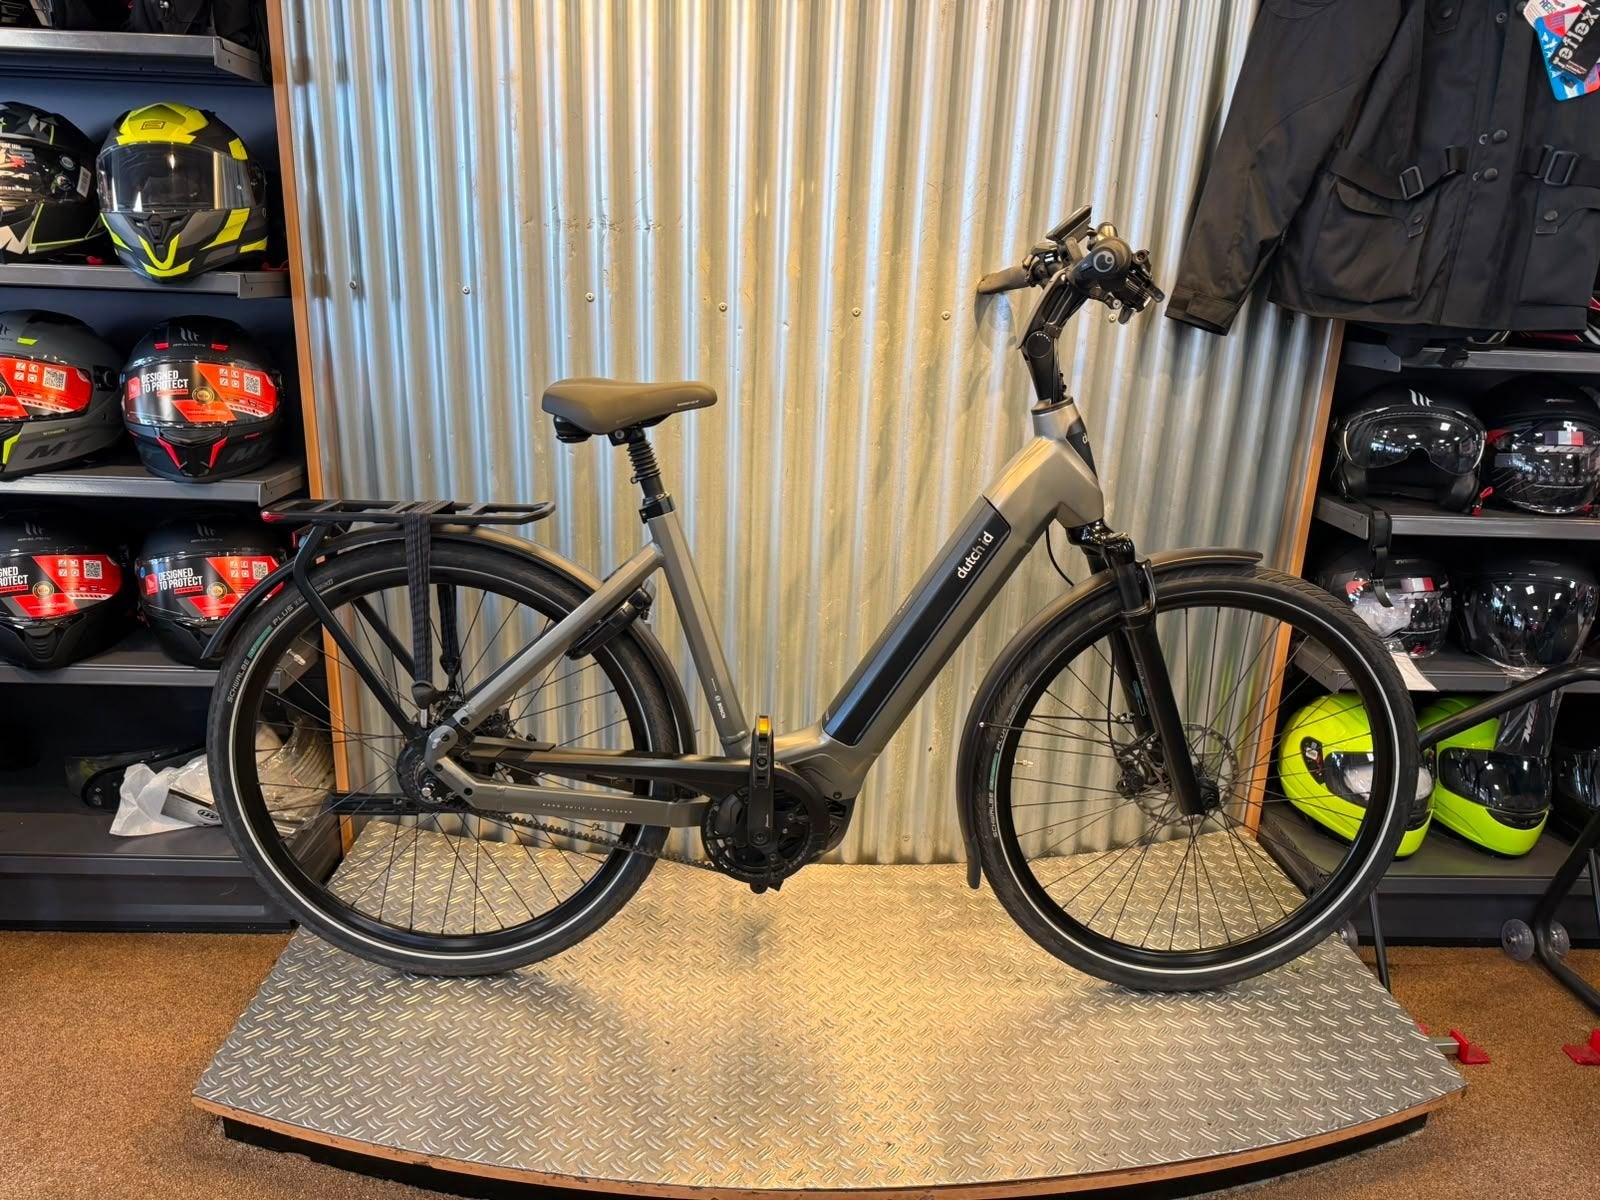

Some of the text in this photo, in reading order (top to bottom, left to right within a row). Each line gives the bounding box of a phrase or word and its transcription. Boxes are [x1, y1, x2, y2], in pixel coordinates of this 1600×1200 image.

[1552, 9, 1600, 69] reflex
[142, 370, 179, 385] DESIGNED
[151, 379, 189, 392] PROTECT
[957, 531, 994, 579] dutch id
[158, 567, 194, 581] DESIGNED
[160, 580, 168, 591] TO
[168, 576, 203, 590] PROTECT
[228, 606, 294, 703] SCHWALBE PLUS
